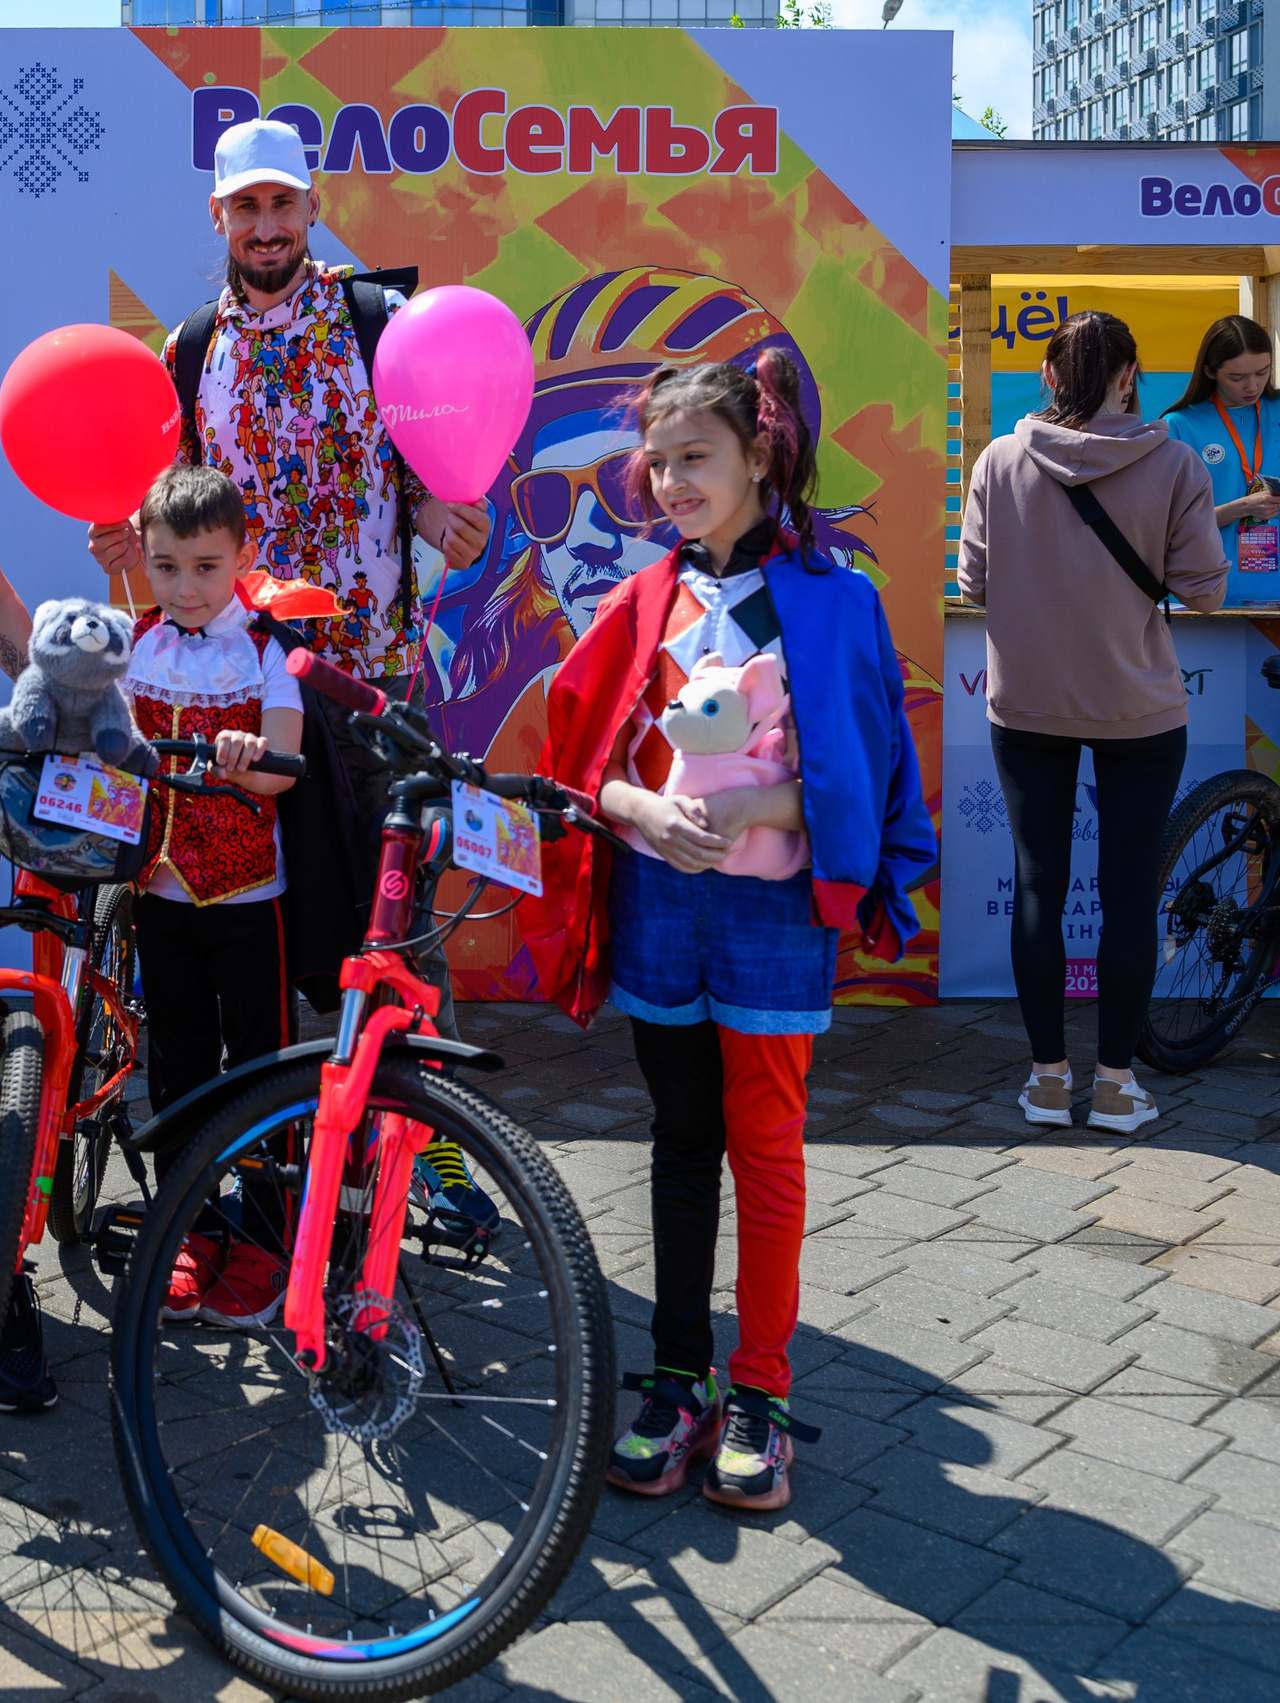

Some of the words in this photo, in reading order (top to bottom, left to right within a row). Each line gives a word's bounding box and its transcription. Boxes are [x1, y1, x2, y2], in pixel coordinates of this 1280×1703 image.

[192, 87, 779, 175] ВелоСемья
[39, 795, 82, 813] 06246
[1065, 977, 1099, 991] 202
